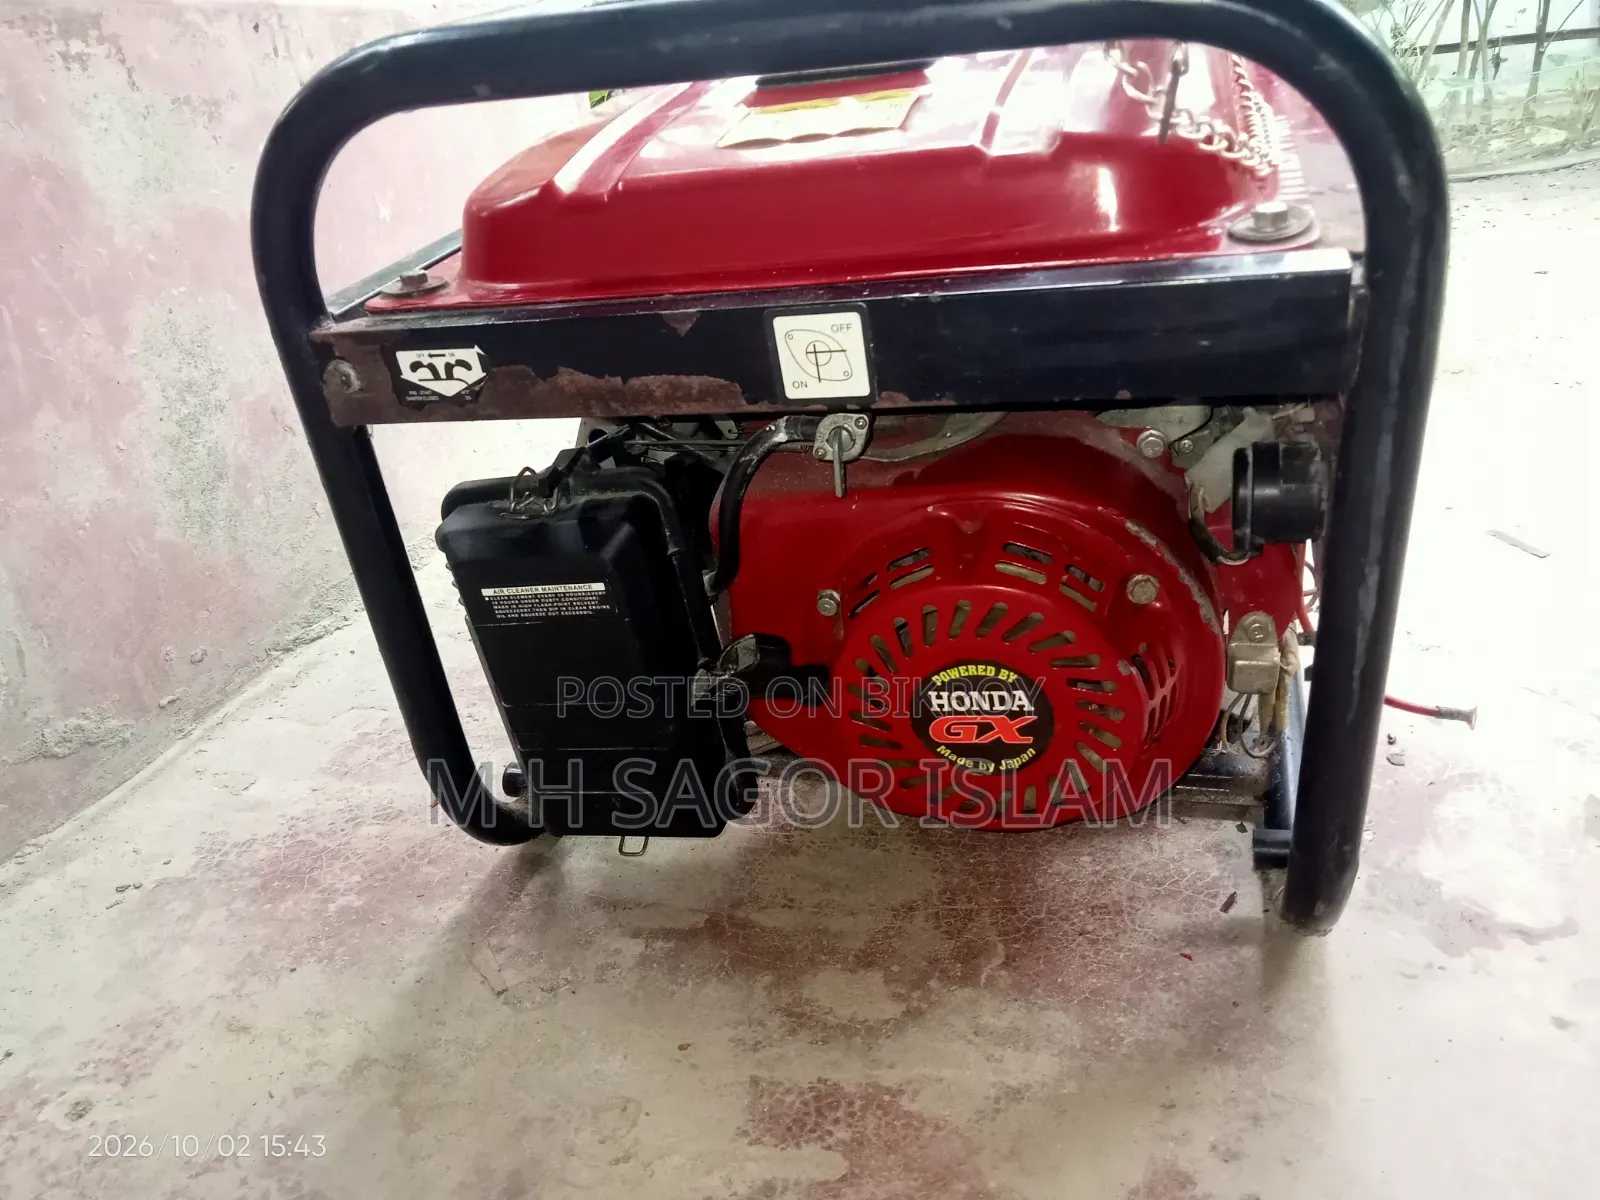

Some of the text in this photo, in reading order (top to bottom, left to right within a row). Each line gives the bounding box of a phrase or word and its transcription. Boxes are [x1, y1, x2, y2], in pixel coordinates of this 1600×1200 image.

[830, 323, 852, 333] OFF
[792, 380, 808, 389] ON
[932, 665, 1018, 686] POWERED BY
[928, 690, 1034, 712] HONDA
[929, 715, 1038, 744] GX
[936, 745, 1036, 772] Made by Japan
